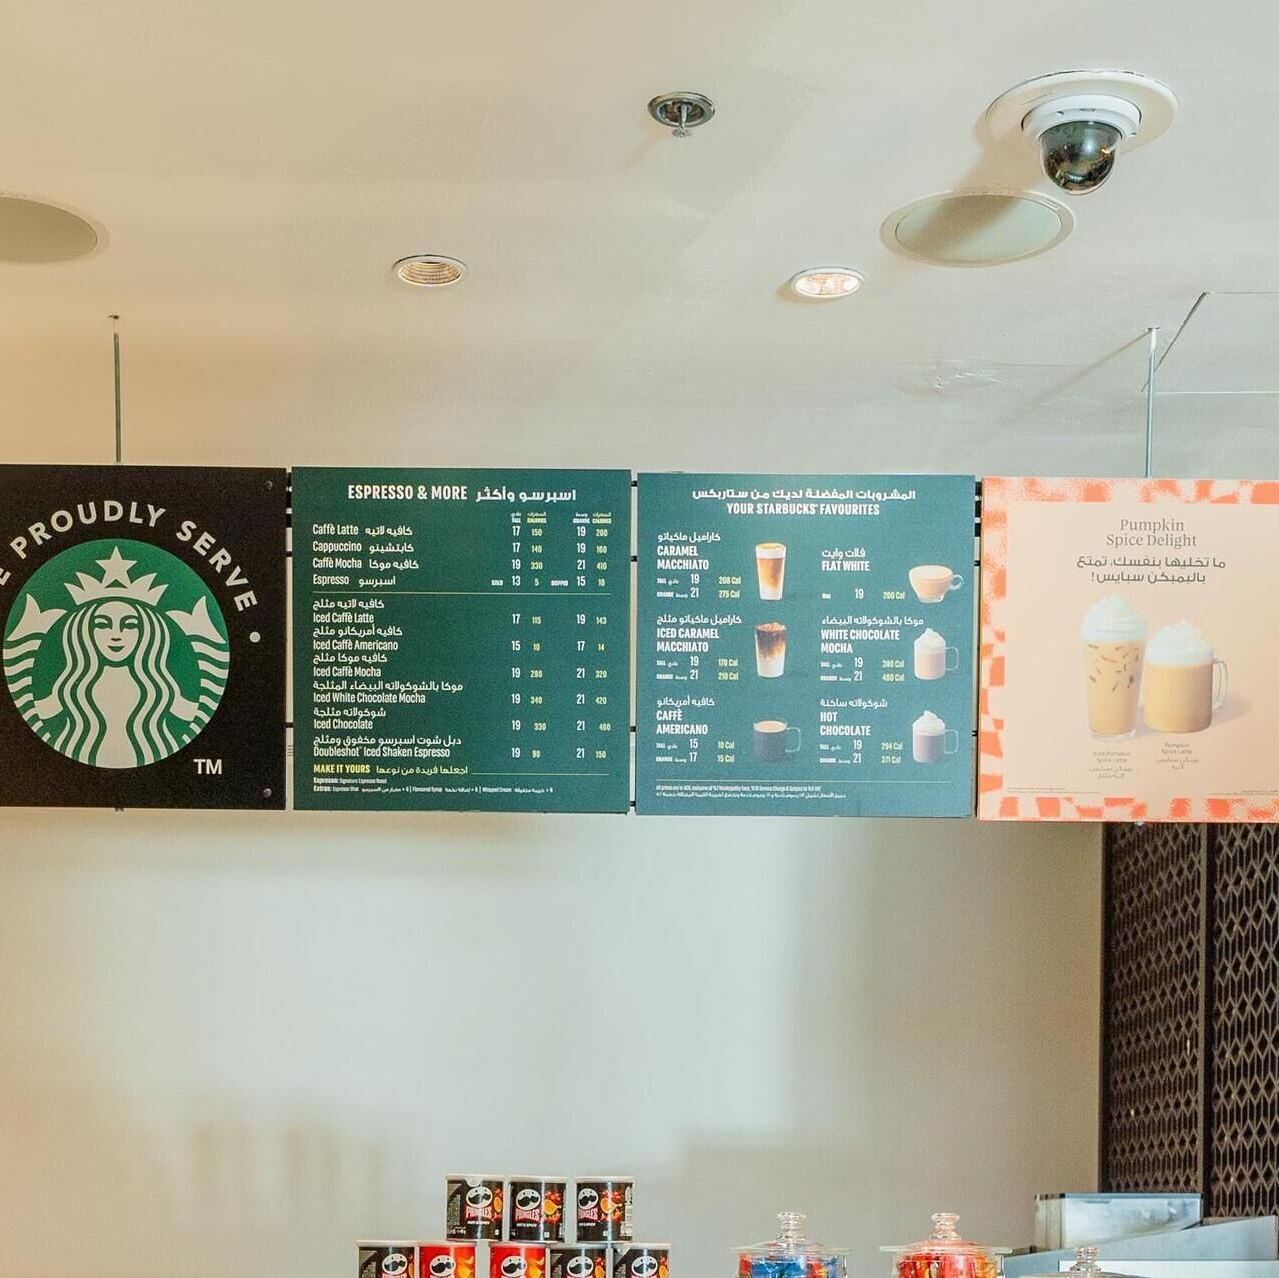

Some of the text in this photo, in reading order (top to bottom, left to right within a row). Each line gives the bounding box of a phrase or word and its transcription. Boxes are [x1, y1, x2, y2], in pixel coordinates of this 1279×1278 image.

[348, 484, 468, 500] ESPRESSO & MORE
[726, 502, 754, 515] YOUR
[819, 503, 880, 516] FAVOURITES
[336, 524, 359, 536] Latte
[512, 525, 521, 537] 17
[576, 525, 587, 537] 19
[1120, 518, 1184, 534] Pumpkin
[312, 540, 363, 554] Cappuccino
[1106, 532, 1197, 550] Spice Delight
[512, 542, 521, 553] 17
[576, 542, 586, 554] 19
[656, 545, 699, 557] CARAMEL
[10, 500, 167, 560] PROUDLY
[176, 519, 258, 612] SERVE
[334, 557, 363, 569] Mocha
[511, 558, 521, 570] 19
[576, 558, 586, 570] 21
[656, 558, 710, 571] MACCHIATO
[821, 560, 870, 572] FLAT WHITE
[312, 573, 350, 587] Espresso
[511, 575, 521, 587] 13
[576, 575, 586, 587] 15
[690, 573, 700, 585] 19
[690, 586, 699, 598] 21
[854, 588, 865, 600] 19
[313, 611, 331, 623] Iced
[354, 612, 375, 624] Latte
[656, 627, 720, 639] ICED CARAMEL
[820, 629, 900, 641] WHITE CHOCOLATE
[313, 639, 331, 651] Iced
[353, 639, 399, 651] Americano
[656, 641, 709, 653] MACCHIATO
[820, 642, 854, 654] MOCHA
[313, 665, 331, 677] Iced
[354, 665, 382, 678] Mocha
[313, 691, 426, 704] Iced White Chocolate Mocha
[819, 711, 838, 723] HOT
[313, 717, 374, 730] Iced Chocolate
[656, 723, 709, 735] AMERICANO
[819, 724, 871, 736] CHOCOLATE
[363, 746, 382, 757] Iced
[382, 746, 413, 758] Shaken
[413, 746, 451, 759] Espresso
[193, 758, 223, 776] TM
[313, 763, 371, 774] MAKE IT YOURS
